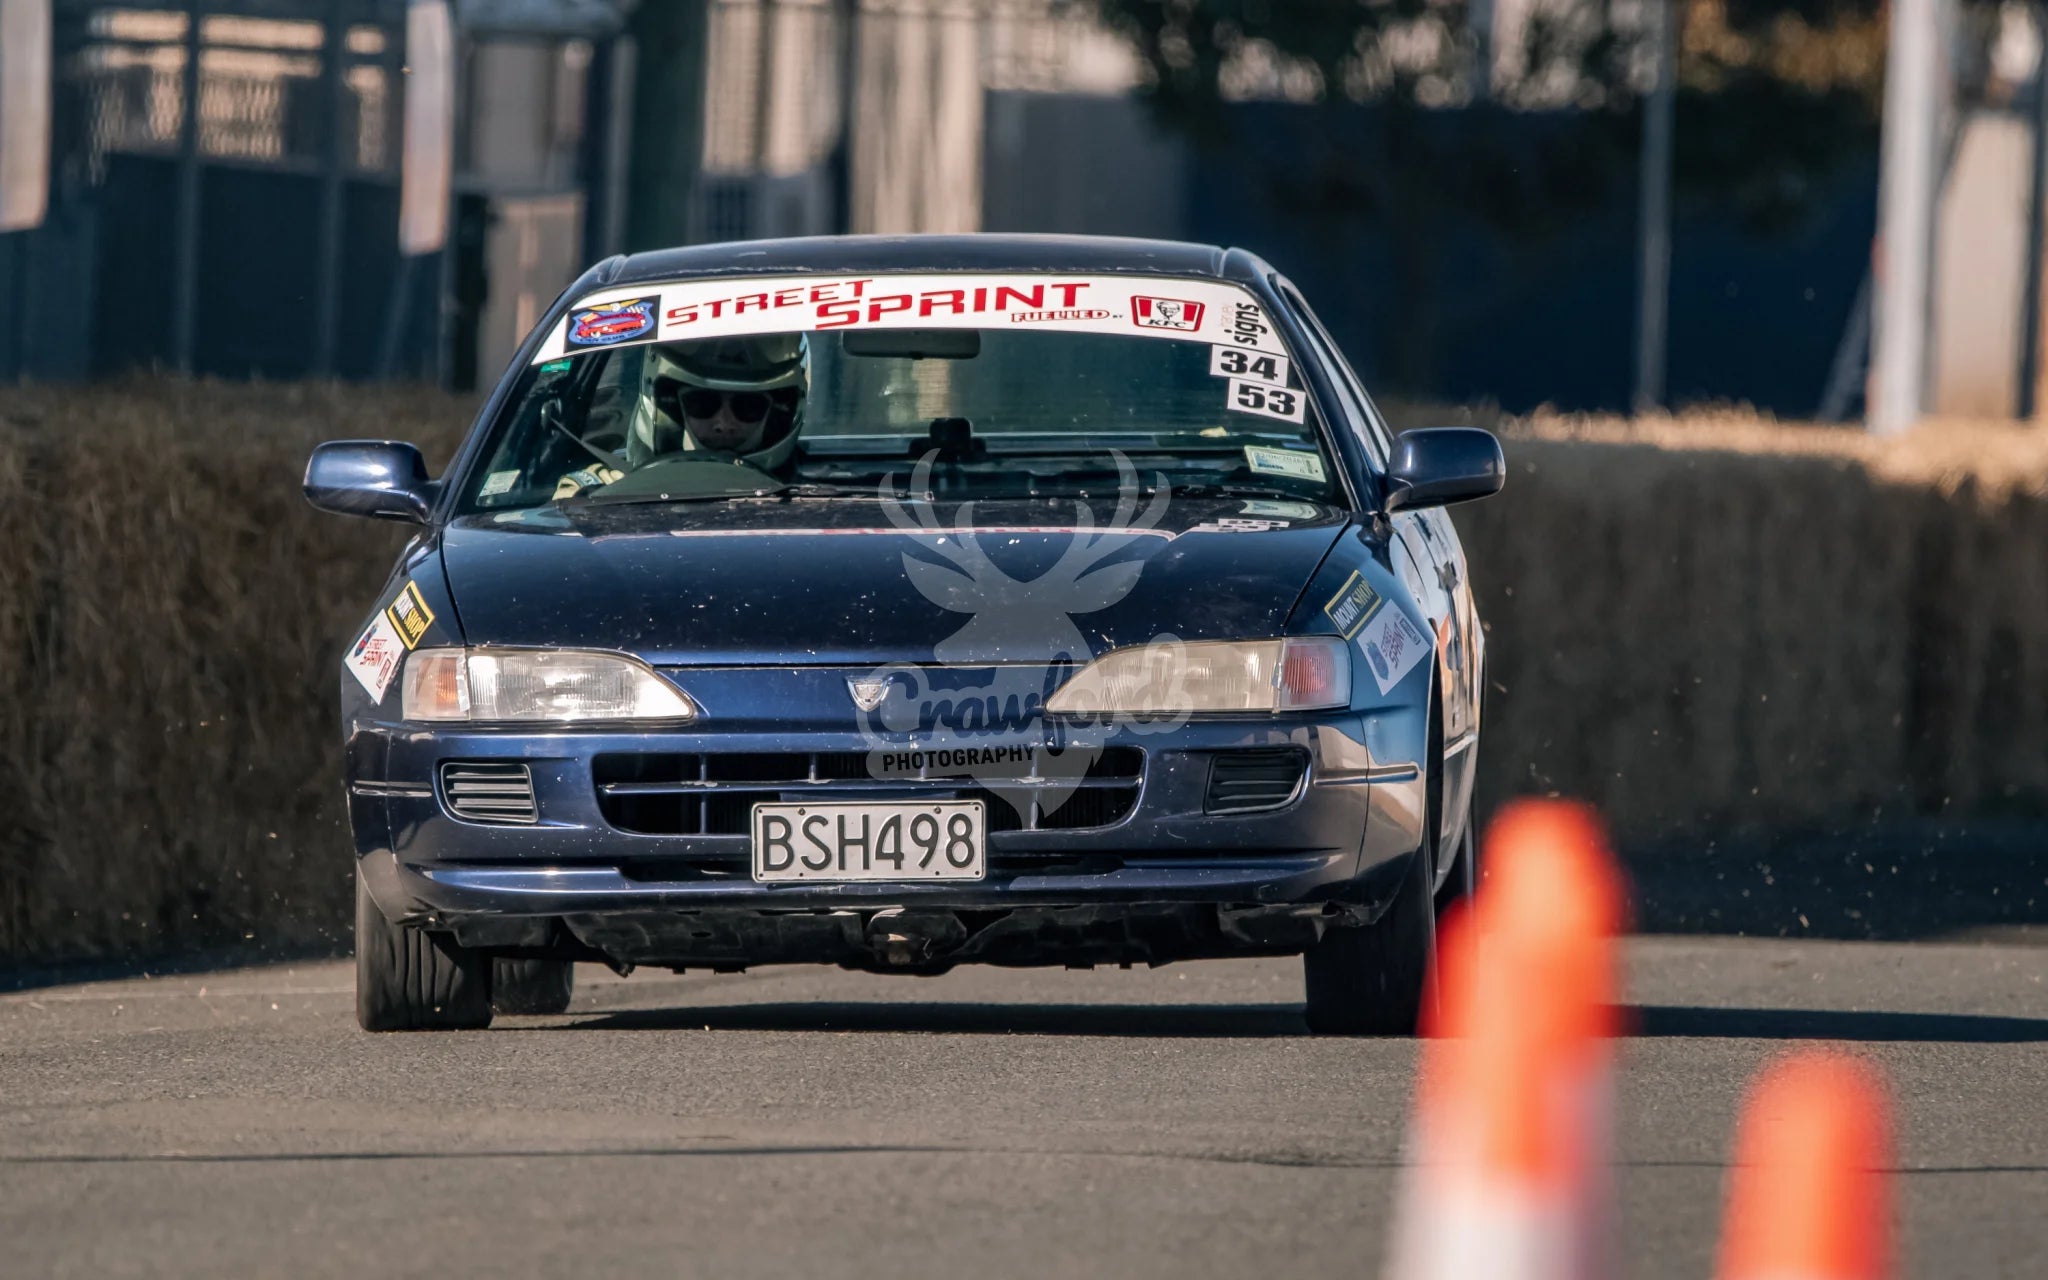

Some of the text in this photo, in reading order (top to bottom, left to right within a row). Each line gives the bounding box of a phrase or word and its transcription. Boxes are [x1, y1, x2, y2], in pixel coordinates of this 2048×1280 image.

[666, 279, 873, 327] STREET
[815, 283, 1090, 330] SPRINT
[1011, 310, 1109, 322] FUELLED
[1148, 318, 1187, 329] KFC
[1223, 302, 1268, 346] signs
[1220, 350, 1279, 380] 34
[1237, 383, 1296, 416] 53
[404, 607, 427, 638] SHOP
[1333, 580, 1375, 630] MOUNT SHOP
[762, 813, 975, 872] BSH498
